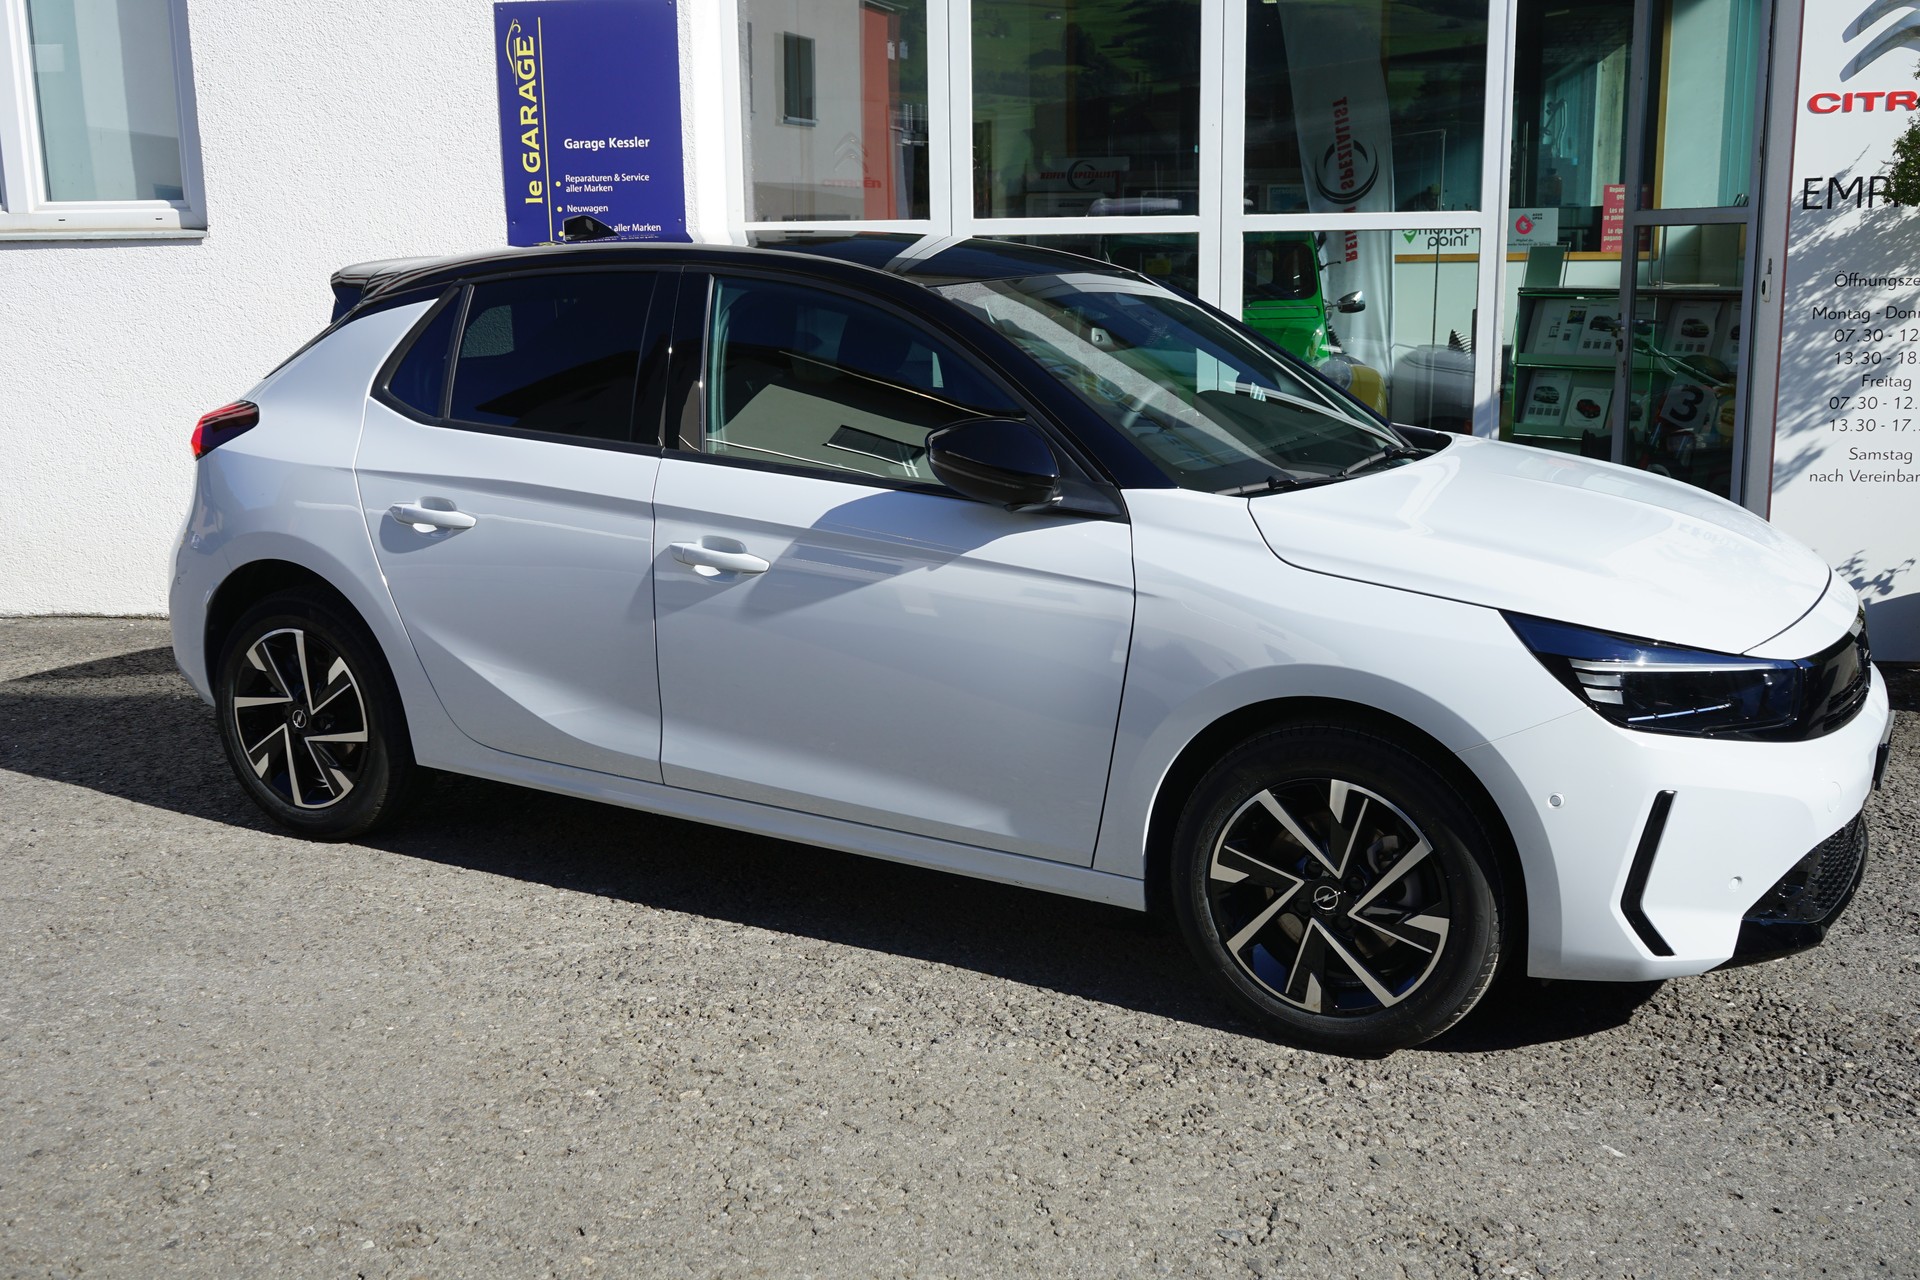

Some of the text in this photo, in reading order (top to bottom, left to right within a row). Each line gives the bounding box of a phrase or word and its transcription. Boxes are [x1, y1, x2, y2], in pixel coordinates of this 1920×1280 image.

[515, 35, 543, 204] le GARAGE
[564, 136, 650, 151] Garage Kessler
[565, 173, 650, 184] Reparaturen & Service
[1073, 170, 1117, 179] SPEZIALIST
[584, 184, 613, 192] Marken
[566, 205, 609, 214] Neuwagen
[613, 224, 631, 232] aller
[632, 223, 662, 231] Marken
[1427, 234, 1469, 250] point
[1812, 306, 1871, 324] Montag
[1834, 328, 1883, 343] 07.30
[1835, 351, 1882, 365] 13.30
[1861, 374, 1912, 391] Freitag
[1668, 384, 1705, 423] 3
[1829, 396, 1878, 410] 07.30
[1829, 418, 1876, 432] 13.30
[1848, 446, 1913, 464] Samstag
[1809, 468, 1844, 482] nach
